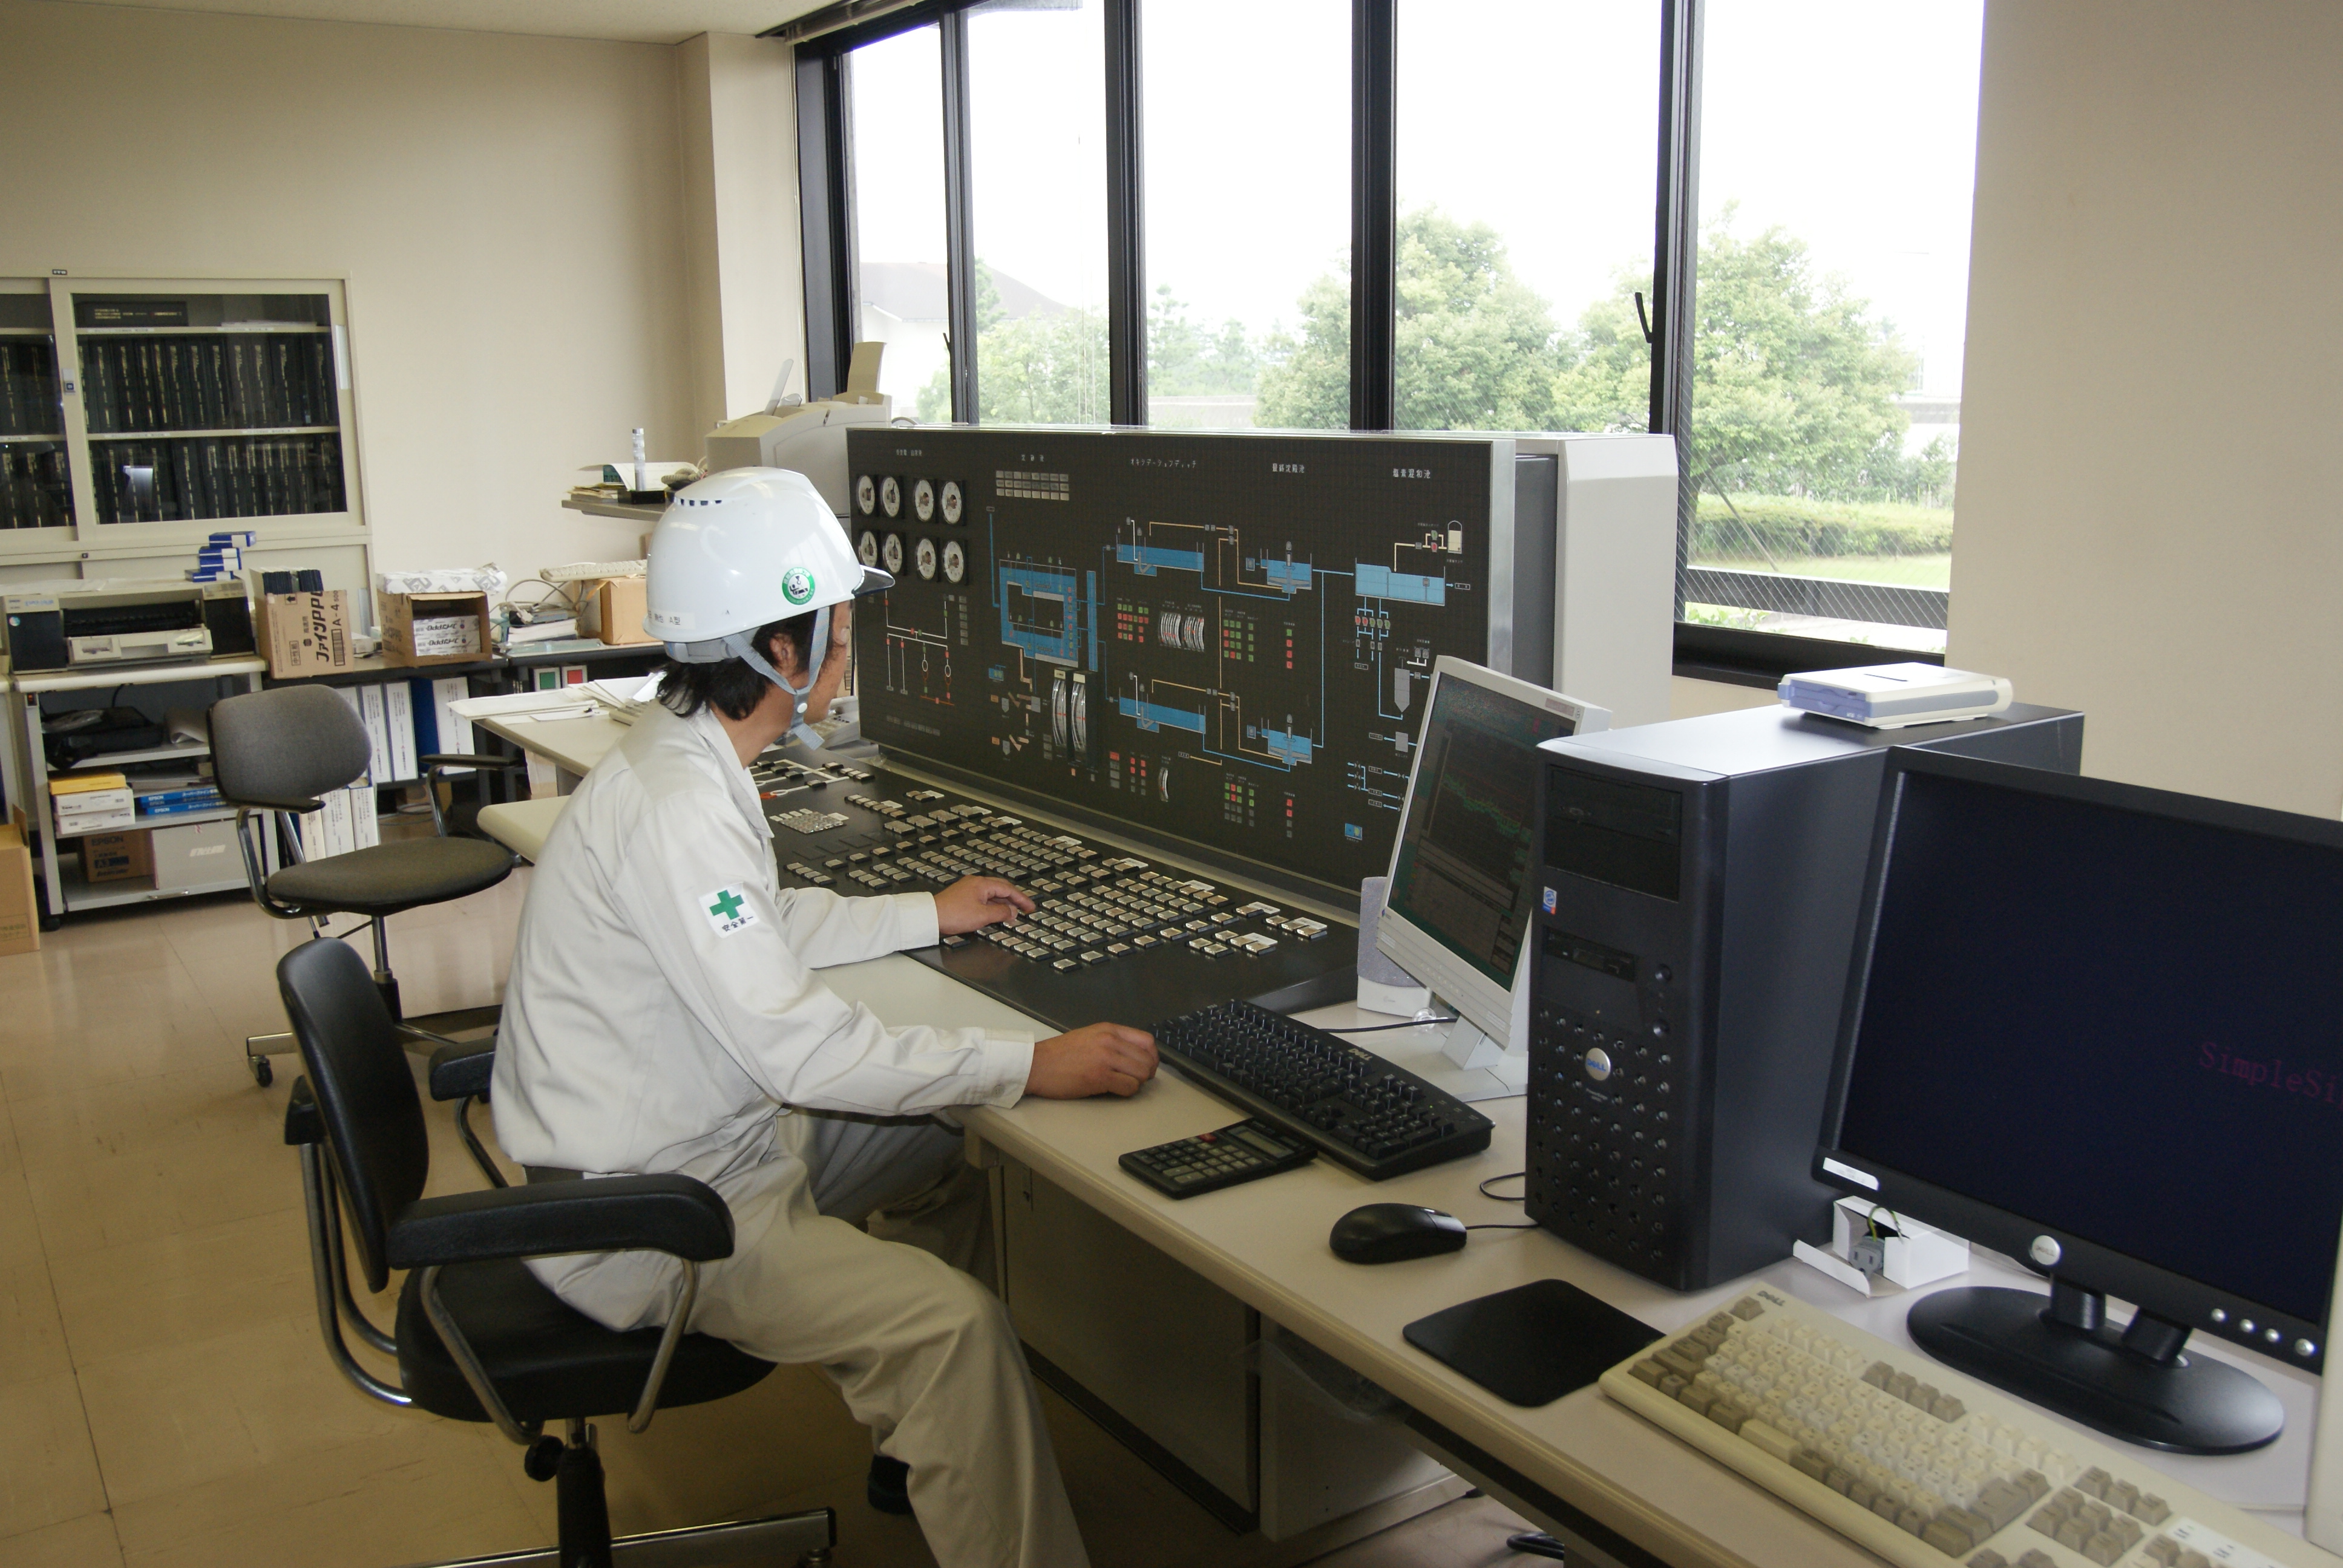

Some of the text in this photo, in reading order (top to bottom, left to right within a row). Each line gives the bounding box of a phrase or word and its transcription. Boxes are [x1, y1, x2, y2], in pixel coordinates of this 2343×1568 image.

[91, 835, 124, 846] EPSON
[722, 916, 753, 932] 安全第一
[1348, 1048, 1372, 1060] DELL
[1587, 1058, 1607, 1073] DELL
[2199, 1041, 2343, 1110] SimpleSi
[1756, 1290, 1786, 1307] DELL
